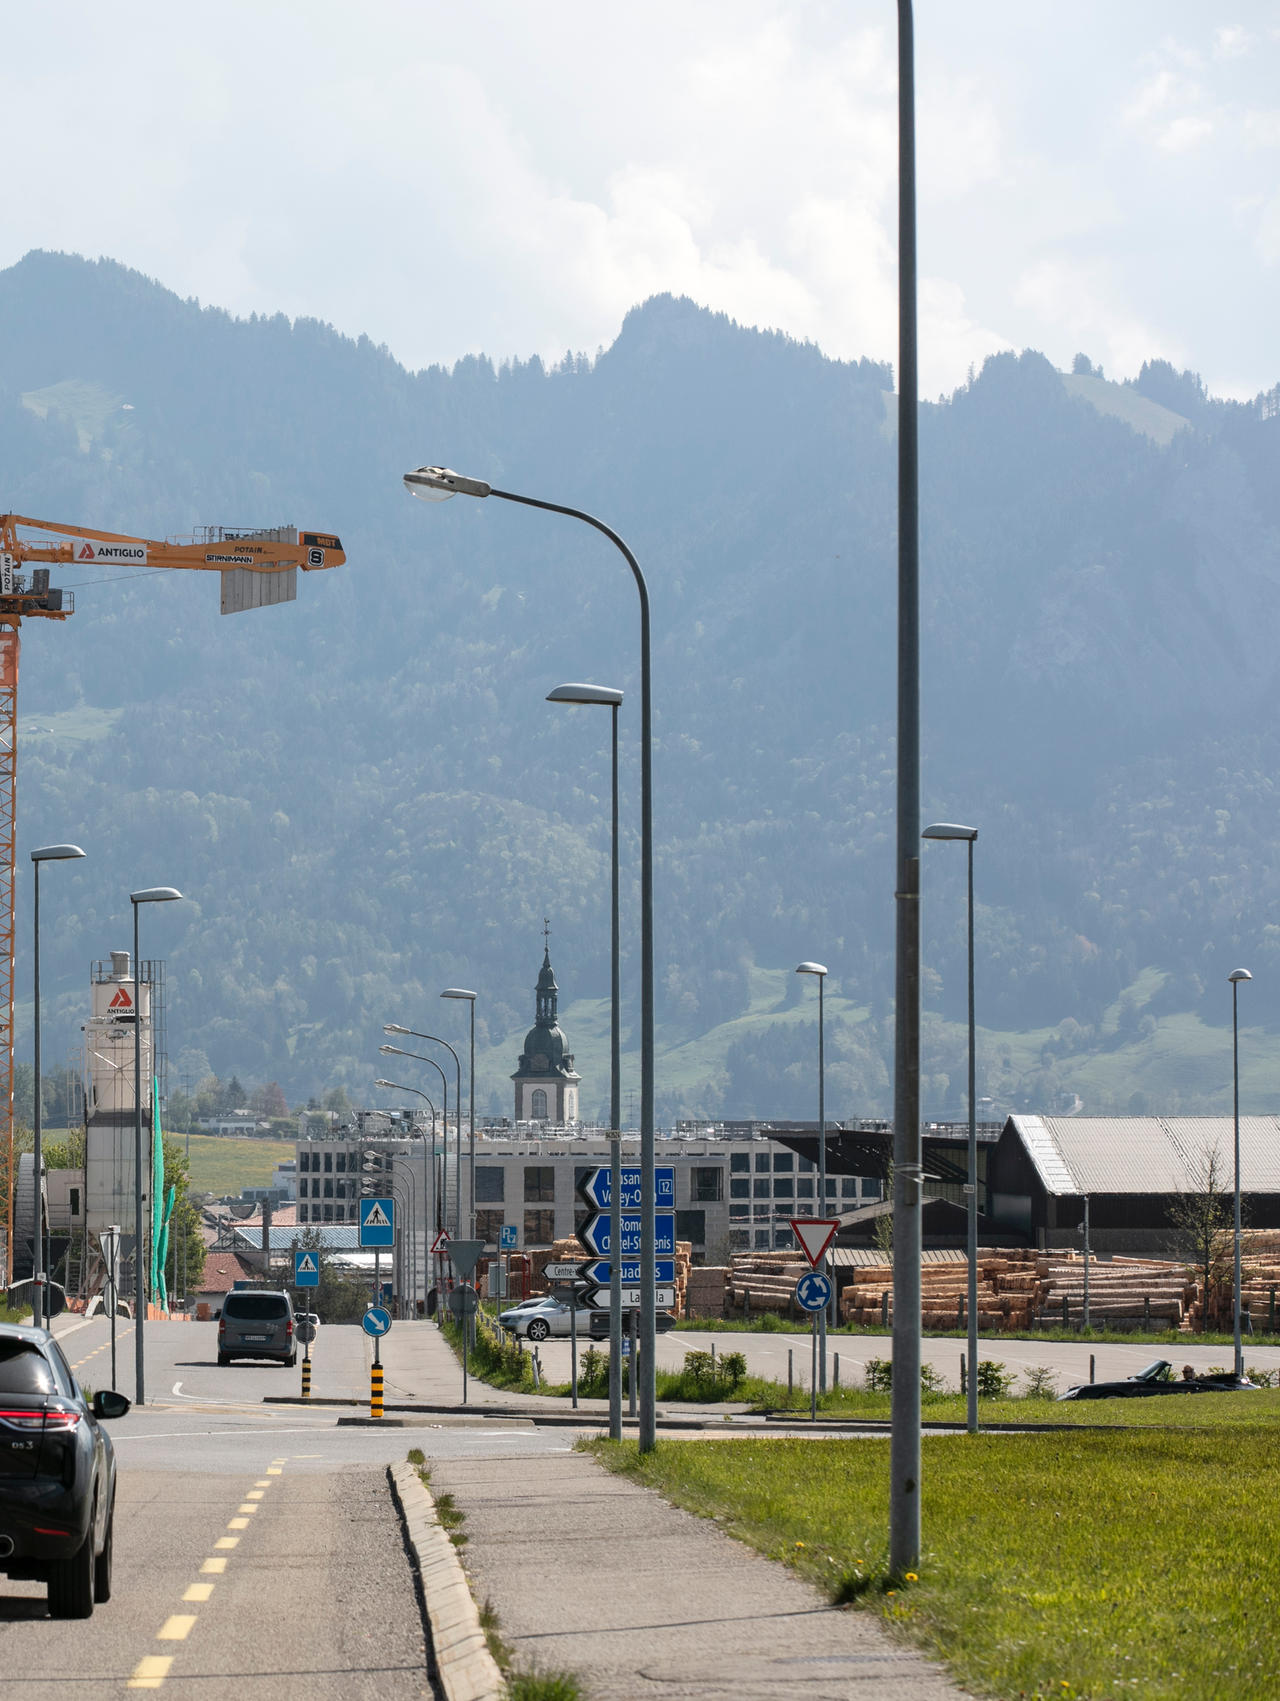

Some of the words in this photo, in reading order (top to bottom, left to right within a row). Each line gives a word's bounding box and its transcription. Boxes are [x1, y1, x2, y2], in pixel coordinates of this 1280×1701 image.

[316, 537, 336, 547] MDT
[97, 547, 145, 558] ANTIGLIO
[234, 546, 263, 554] POTAIN
[206, 554, 253, 563] STIRNIMANN
[554, 1266, 577, 1277] Centre-
[621, 1264, 661, 1279] uads
